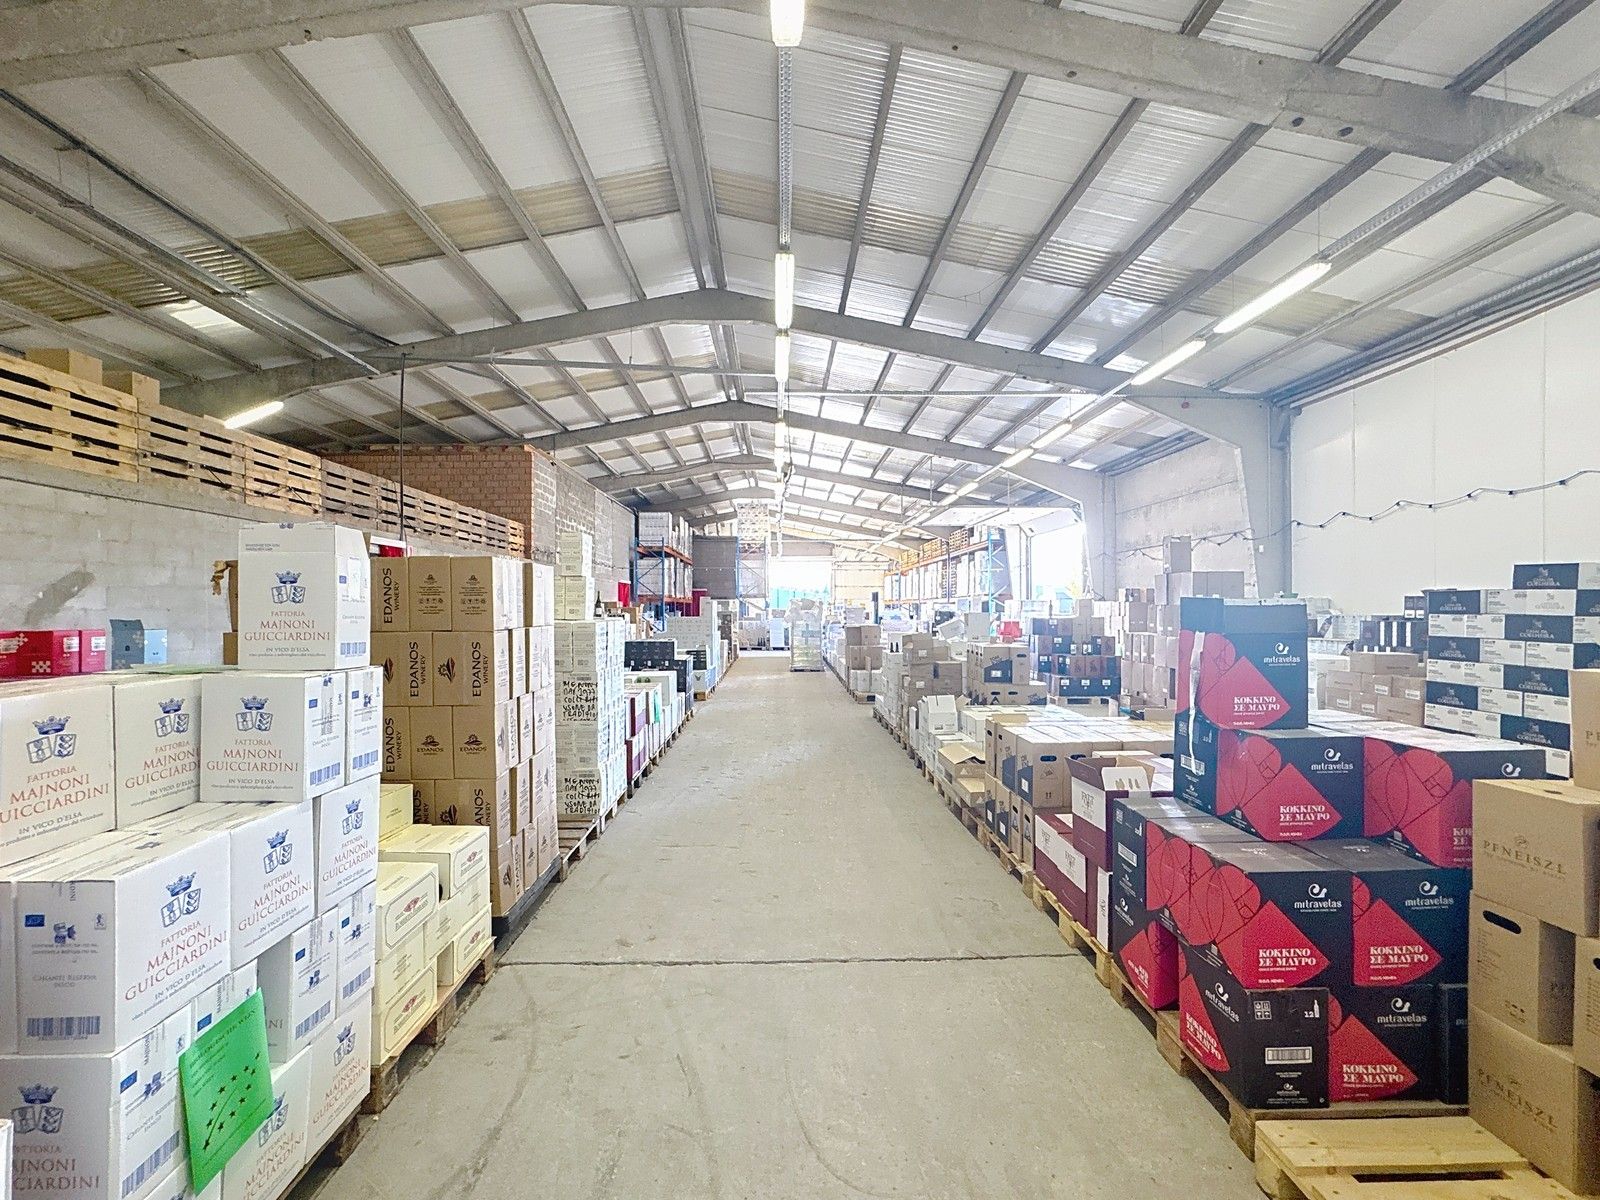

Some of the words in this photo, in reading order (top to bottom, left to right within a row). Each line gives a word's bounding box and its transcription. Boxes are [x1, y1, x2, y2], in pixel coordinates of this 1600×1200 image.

[382, 568, 393, 624] EDANOS
[394, 581, 402, 611] WINERY
[259, 620, 316, 630] MAJNONI
[244, 631, 331, 642] GUICCIARDINI
[1263, 655, 1301, 664] mitravelas
[408, 641, 420, 697] EDANOS
[419, 654, 428, 685] WINERY
[471, 641, 482, 697] EDANOS
[482, 655, 491, 685] WINERY
[1233, 695, 1277, 705] ΚΟΚΚΙΝΟ
[1233, 705, 1247, 713] ΣΕ
[1249, 704, 1281, 712] ΜΑΥΡΟ
[155, 741, 190, 755] FATTORIA
[384, 717, 396, 773] EDANOS
[222, 749, 283, 759] MAJNONI
[206, 761, 299, 773] GUICCIARDINI
[1311, 762, 1353, 771] mitravelas
[27, 765, 78, 784] FATTORIA
[9, 773, 90, 805] MAJNONI
[0, 782, 110, 824] UICCIARDINI
[413, 789, 421, 825] ANOS
[472, 788, 483, 826] ANOS
[1279, 804, 1326, 814] ΚΟΚΚΙΝΟ
[1279, 814, 1293, 822] ΣΕ
[1296, 812, 1330, 821] ΜΑΥΡΟ
[334, 841, 369, 866] MAJNONI
[263, 869, 294, 891] FATTORIA
[253, 874, 301, 910] MAJNONI
[237, 881, 313, 932] GUICCIARDINI
[1294, 899, 1343, 910] mitravelas
[1405, 896, 1455, 907] mitravelas
[161, 920, 201, 948] FATTORIA
[146, 925, 212, 973] MAJNONI
[1258, 948, 1312, 957] ΚΟΚΚΙΝΟ
[1370, 945, 1424, 955] ΚΟΚΚΙΝΟ
[1258, 957, 1274, 966] ΣΕ
[1276, 957, 1318, 967] ΜΑΥΡΟ
[1370, 955, 1385, 964] ΣΕ
[1387, 954, 1429, 963] ΜΑΥΡΟ
[125, 931, 228, 1002] GUICCIARDINI
[1303, 1010, 1315, 1018] 12
[1377, 1012, 1428, 1024] mitravelas
[1342, 1064, 1398, 1074] ΚΟΚΚΙΝΟ
[1343, 1074, 1359, 1083] ΣΕ
[1362, 1073, 1405, 1083] ΜΑΥΡΟ
[14, 1158, 77, 1175] JNONI
